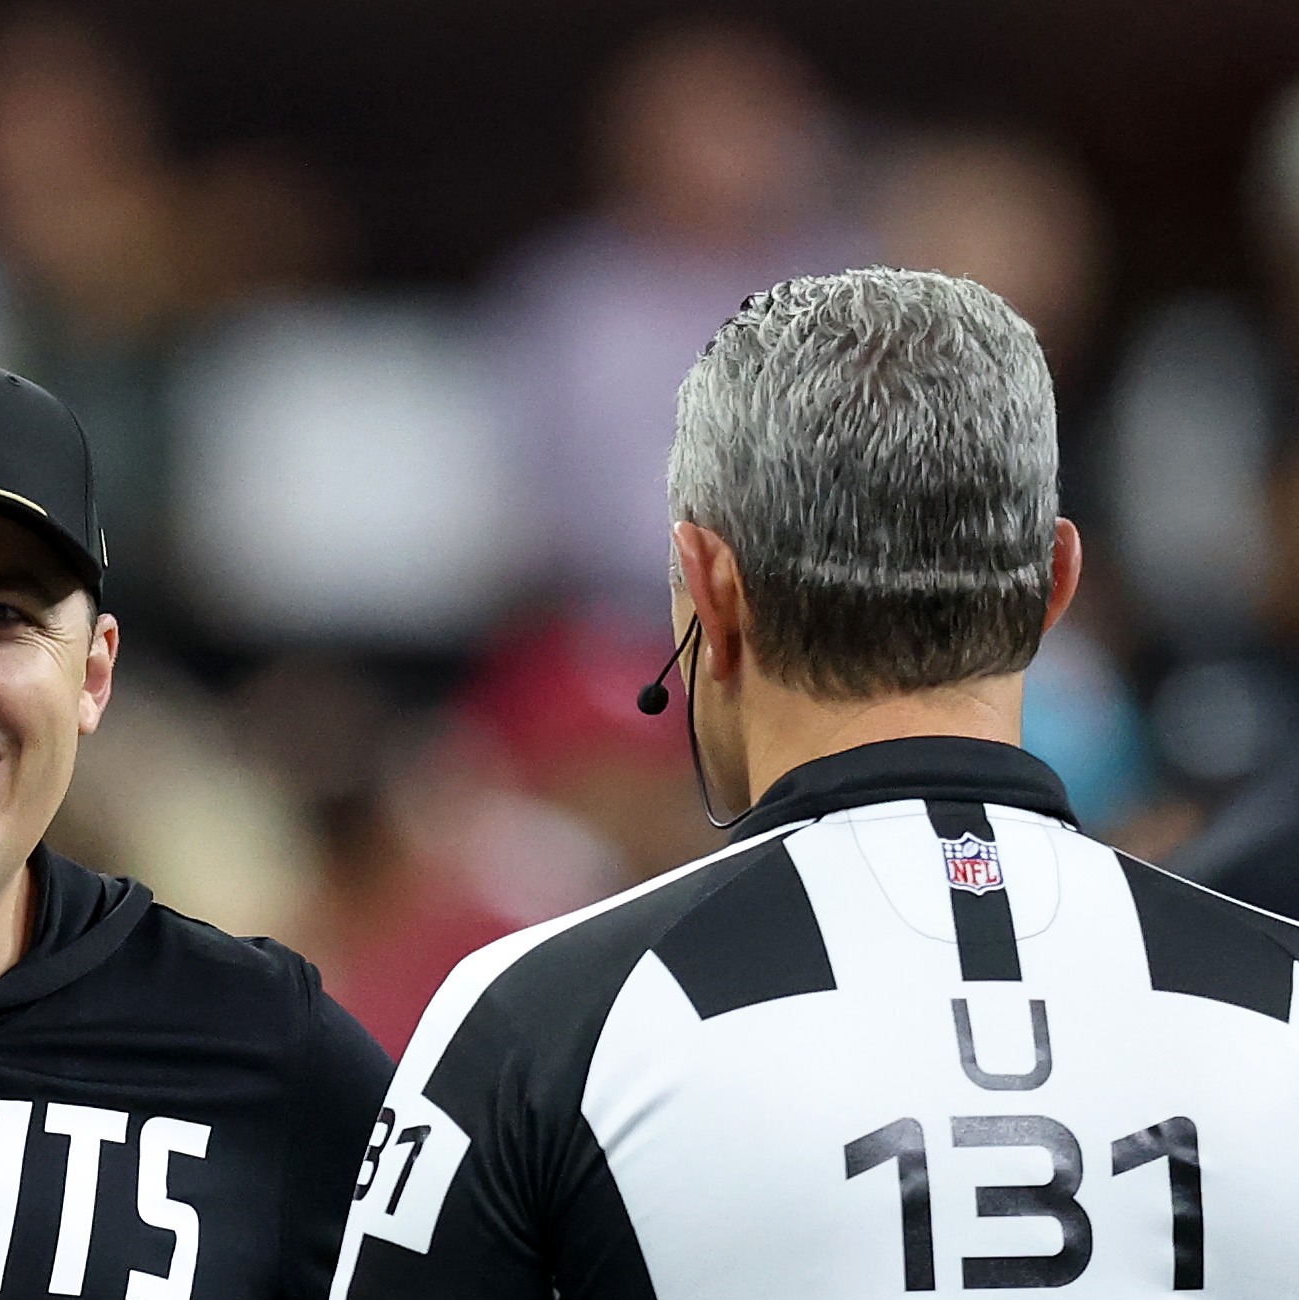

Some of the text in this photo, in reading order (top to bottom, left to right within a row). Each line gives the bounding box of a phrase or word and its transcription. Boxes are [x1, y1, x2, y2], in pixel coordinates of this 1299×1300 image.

[950, 859, 998, 886] NFL
[951, 999, 1053, 1091] U
[843, 1114, 1205, 1293] 131
